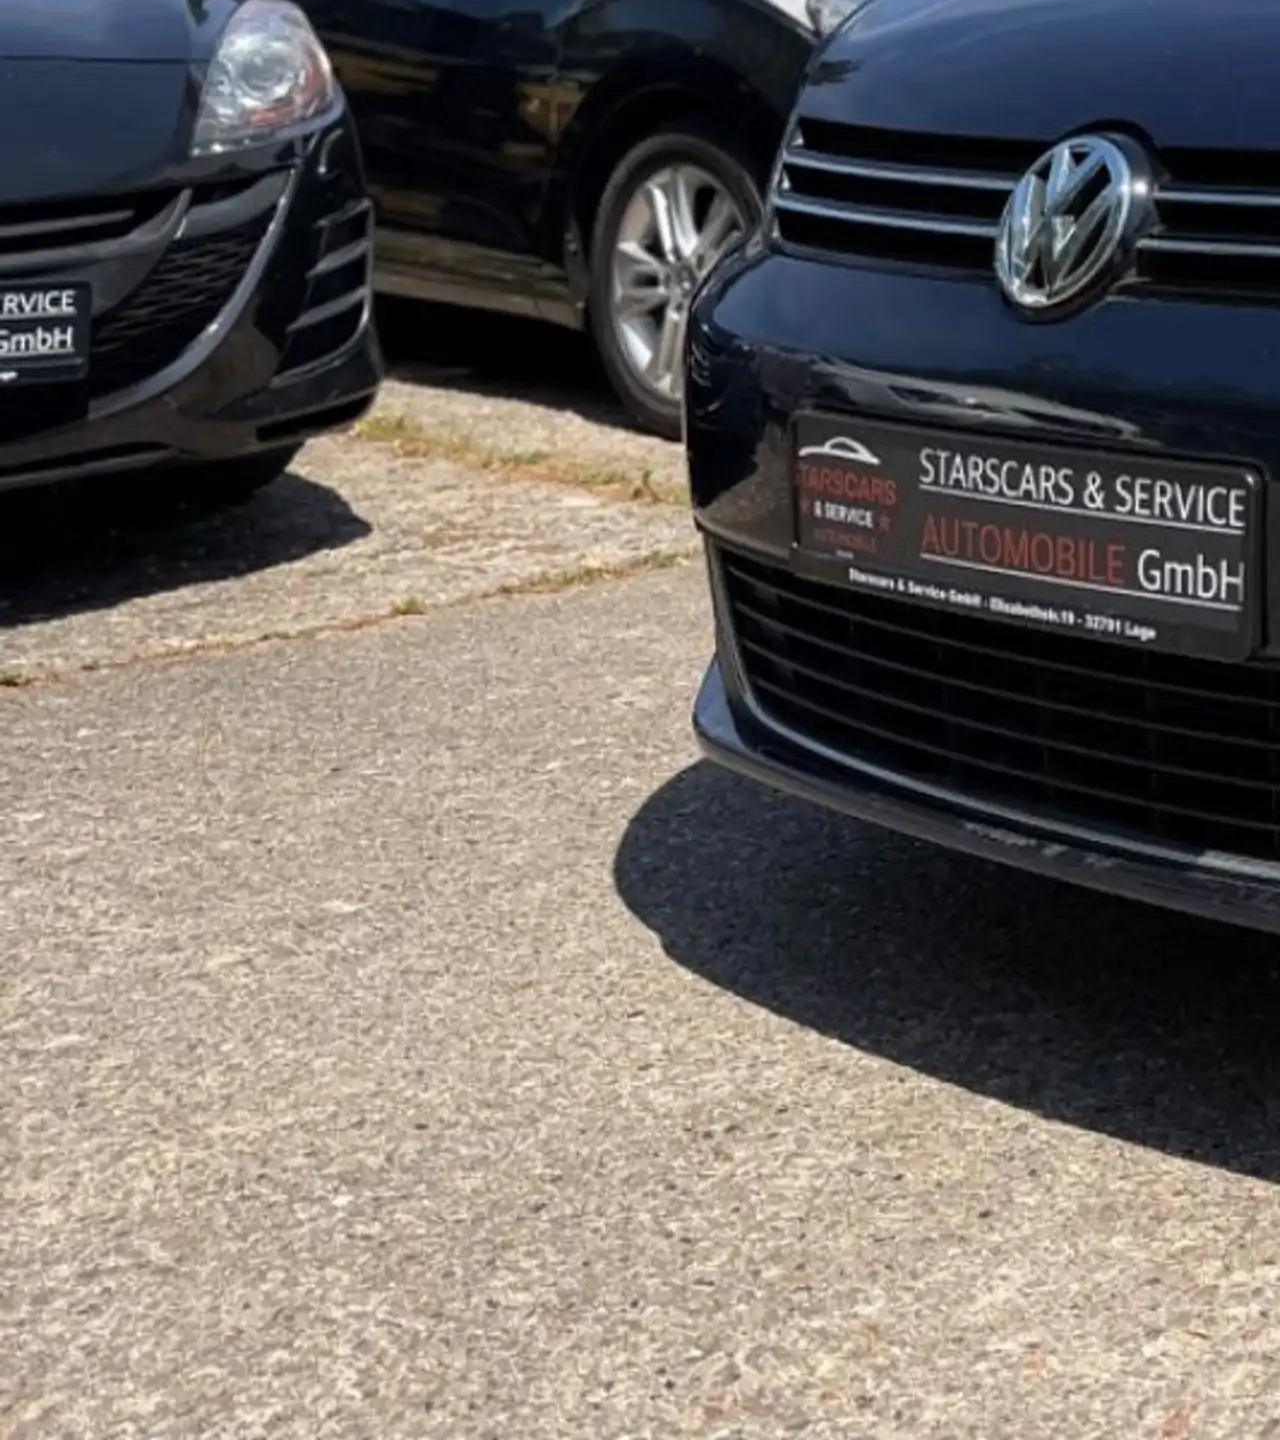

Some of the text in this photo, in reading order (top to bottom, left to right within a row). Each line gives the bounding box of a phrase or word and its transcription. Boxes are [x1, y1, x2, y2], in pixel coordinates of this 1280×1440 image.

[0, 288, 77, 316] RVICE
[919, 447, 1246, 528] STARSCARS & SERVICE
[921, 515, 1126, 585] AUTOMOBILE
[1137, 551, 1245, 602] GmbH
